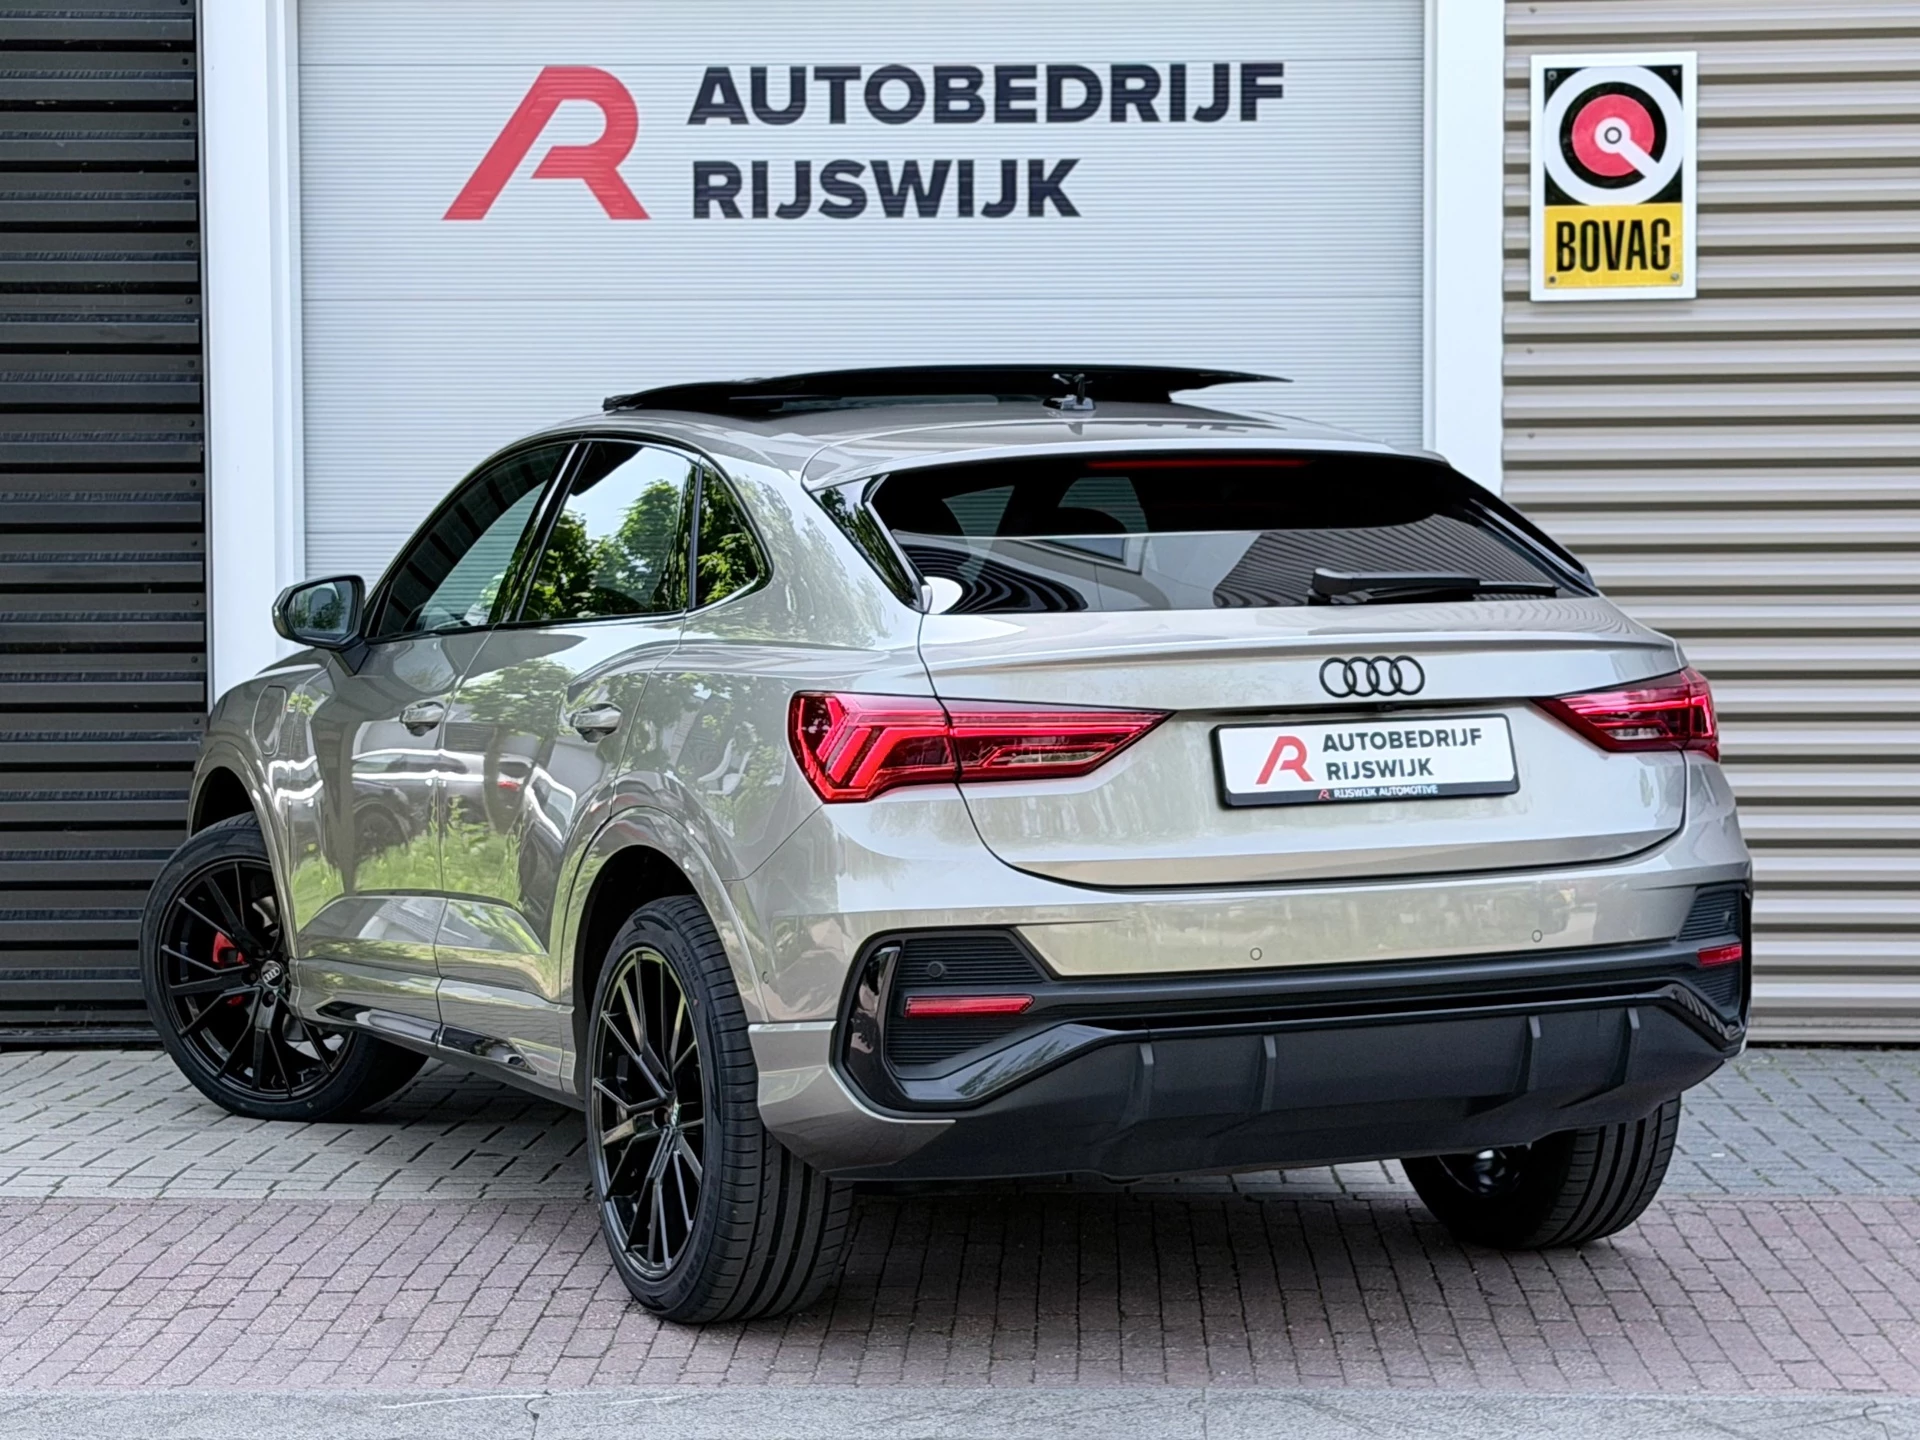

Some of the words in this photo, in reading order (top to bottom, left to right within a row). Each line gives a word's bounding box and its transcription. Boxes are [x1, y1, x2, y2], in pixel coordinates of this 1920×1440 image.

[687, 62, 1284, 125] AUTOBEDRIJF
[692, 158, 1081, 220] RIJSWIJK
[1555, 217, 1671, 273] BOVAG
[1322, 728, 1482, 752] AUTOBEDRIJF
[1325, 757, 1434, 781] RIJSWIJK
[1333, 787, 1377, 798] RIJSWIJK
[1379, 784, 1438, 796] AUTOMOTIVE
